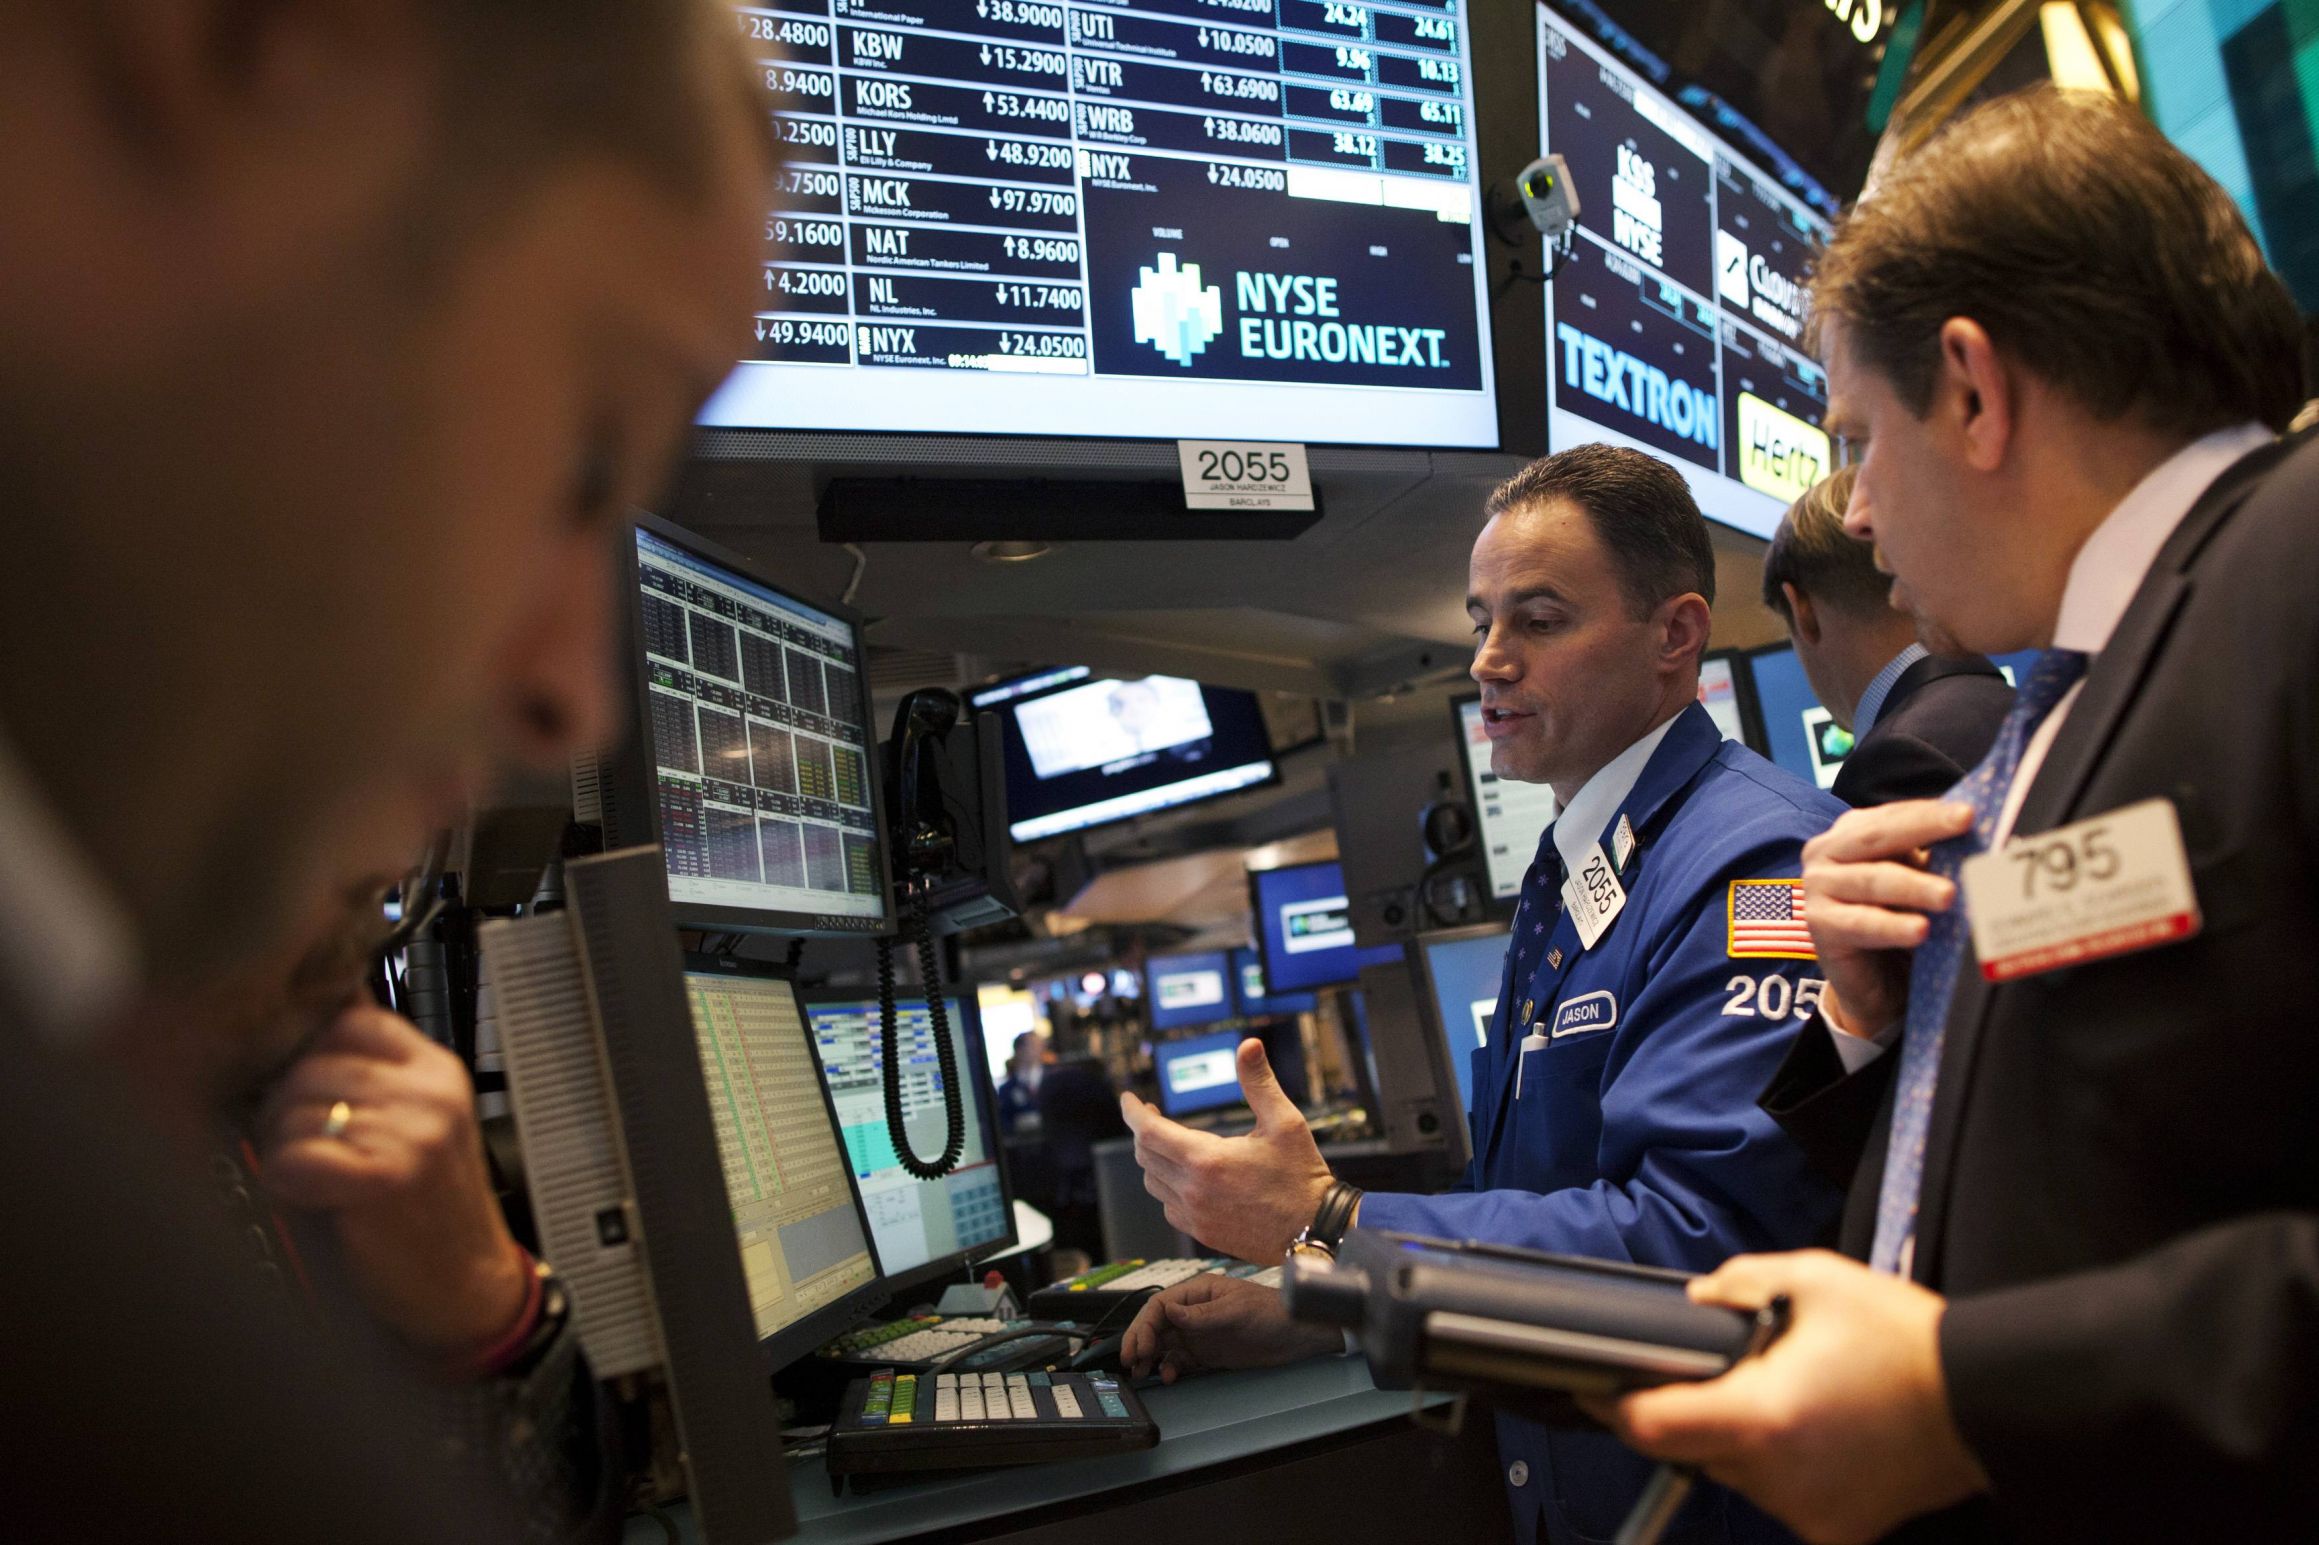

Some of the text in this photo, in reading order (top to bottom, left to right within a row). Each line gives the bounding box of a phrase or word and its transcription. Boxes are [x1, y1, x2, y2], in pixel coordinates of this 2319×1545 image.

[850, 8, 924, 25] International Paper
[992, 0, 1063, 29] 38.9000
[1081, 12, 1114, 40] UTI
[1324, 2, 1368, 27] 24.24
[1414, 15, 1454, 41] 24.61
[750, 17, 829, 47] 28.4800
[853, 30, 903, 60] KBW
[1211, 30, 1275, 57] 10.0500
[853, 57, 888, 69] KBW Inc.
[993, 47, 1066, 76] 15.2900
[1336, 46, 1371, 71] 9.96
[1418, 58, 1459, 83] 10.13
[1084, 59, 1123, 87] VTR
[856, 80, 912, 109] KORS
[1213, 75, 1278, 102] 63.6900
[857, 106, 887, 117] Michael
[888, 110, 906, 120] Kors
[906, 111, 938, 124] Holding
[997, 96, 1069, 123] 53.4400
[1087, 104, 1134, 133] WRB
[1420, 101, 1461, 124] 65.11
[845, 127, 858, 161] S&P100
[859, 129, 896, 156] LLY
[1216, 119, 1281, 146] 38.0600
[860, 155, 933, 171] Eli Lilly & Company
[1000, 142, 1072, 169] 48.9200
[1092, 153, 1131, 180] NYX
[1219, 166, 1284, 191] 24.0500
[848, 177, 862, 211] S&P500
[863, 178, 911, 207] MCK
[1005, 189, 1076, 216] 97.9700
[863, 205, 950, 220] Mckesson Corporation
[765, 221, 842, 246] 59.1600
[866, 228, 909, 255] NAT
[866, 254, 989, 271] Nordic American Tankers Limited
[1017, 238, 1078, 263] 8.9600
[779, 272, 846, 297] 4.2000
[869, 277, 899, 304] NL
[1010, 285, 1082, 310] 11.7400
[1236, 271, 1340, 317] NYSE
[870, 304, 938, 316] NL Industries, Inc.
[769, 322, 848, 347] 49.9400
[872, 327, 916, 354] NYX
[1012, 334, 1084, 358] 24.0500
[873, 354, 947, 365] NYSE Euronext, Inc.
[1556, 321, 1718, 450] TEXTRON
[1198, 450, 1290, 482] 2055
[1751, 418, 1818, 489] Hertz
[1229, 498, 1271, 506] BARCLAYS
[2011, 825, 2121, 899] 795
[1582, 855, 1617, 915] 2055
[1562, 1003, 1599, 1026] JASON
